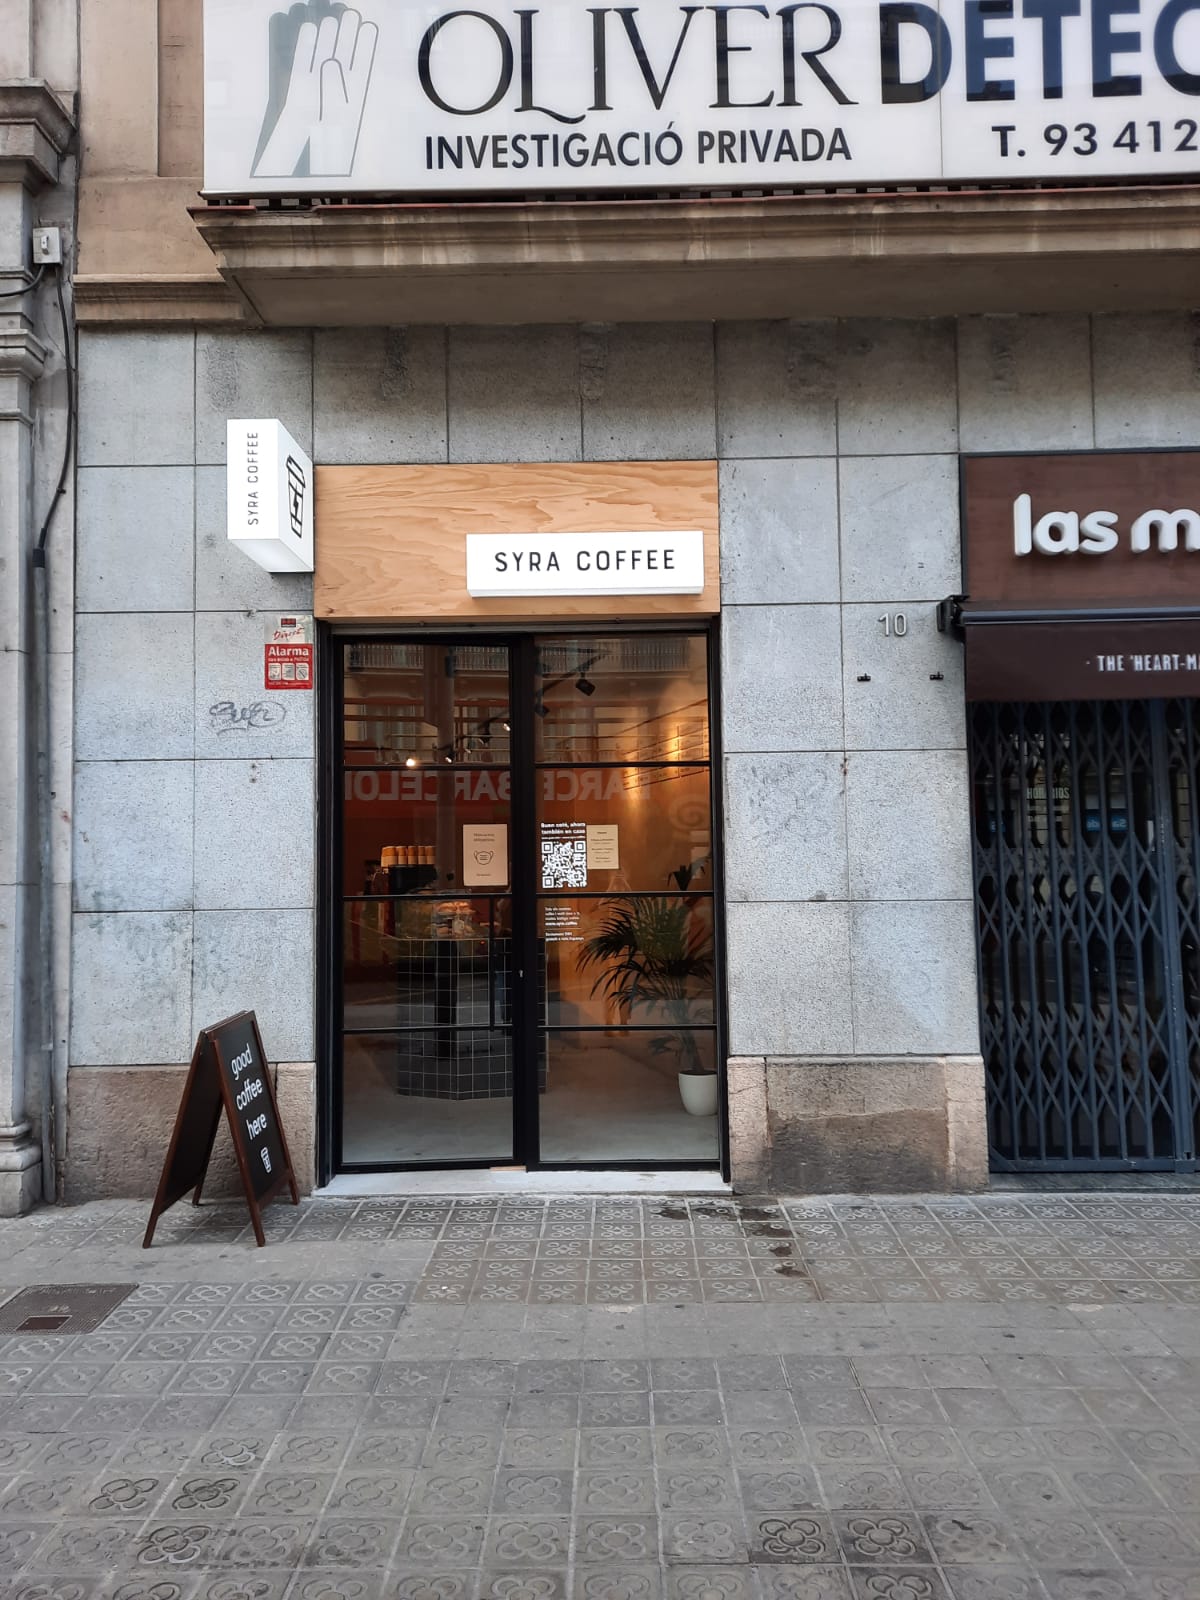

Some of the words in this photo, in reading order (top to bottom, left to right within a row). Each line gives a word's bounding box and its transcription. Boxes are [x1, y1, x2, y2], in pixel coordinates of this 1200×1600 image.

[417, 3, 859, 124] OLIVER
[426, 122, 684, 170] INVESTIGACIÓ
[697, 128, 852, 165] PRIVADA
[991, 125, 1026, 157] T.
[1043, 123, 1098, 157] 93
[1112, 119, 1199, 154] 412
[247, 432, 259, 483] COFFEE
[247, 491, 259, 525] SYRA
[1013, 493, 1119, 557] las
[494, 551, 560, 572] SYRA
[576, 549, 675, 571] COFFEE
[878, 612, 908, 638] 10
[268, 646, 310, 656] Alarma
[1096, 654, 1125, 672] THE
[231, 1043, 253, 1081] good
[235, 1078, 263, 1111] coffee
[246, 1113, 267, 1141] here
